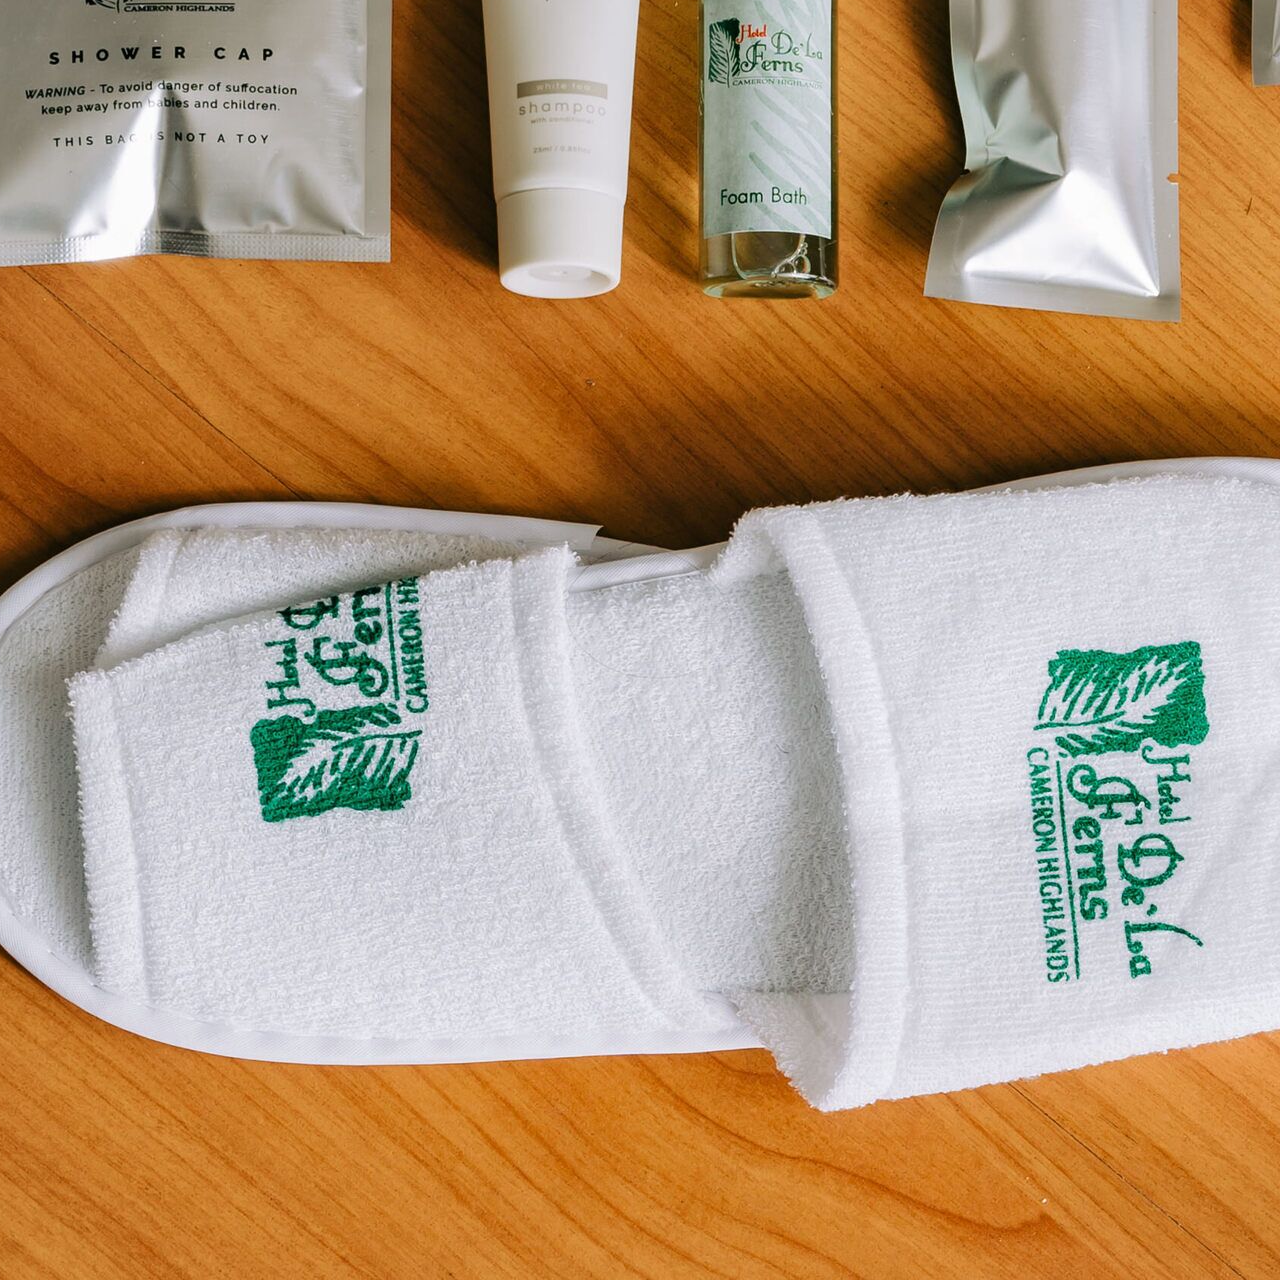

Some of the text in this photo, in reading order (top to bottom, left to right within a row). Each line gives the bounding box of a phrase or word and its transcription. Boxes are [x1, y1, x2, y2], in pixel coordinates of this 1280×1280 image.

[124, 4, 235, 13] CAMERON HIGHLANDS
[735, 24, 767, 44] Hotel
[48, 46, 274, 66] SHOWER CAP
[740, 40, 804, 73] Ferns
[24, 80, 298, 100] WARNING To avoid danger of suffocation
[732, 78, 778, 87] CAMERON
[41, 104, 72, 116] keep
[76, 102, 108, 114] away
[112, 100, 143, 110] from
[194, 98, 218, 108] and
[222, 99, 280, 112] children.
[518, 101, 606, 116] shampoo
[53, 132, 269, 148] THIS NOT A TOY
[720, 186, 807, 206] Foam Bath
[398, 609, 429, 714] CAMERON
[264, 637, 317, 718] Hotel
[1141, 744, 1192, 825] Hotel
[1066, 763, 1152, 921] Ferns
[1026, 746, 1070, 983] CAMERON HIGHLANDS
